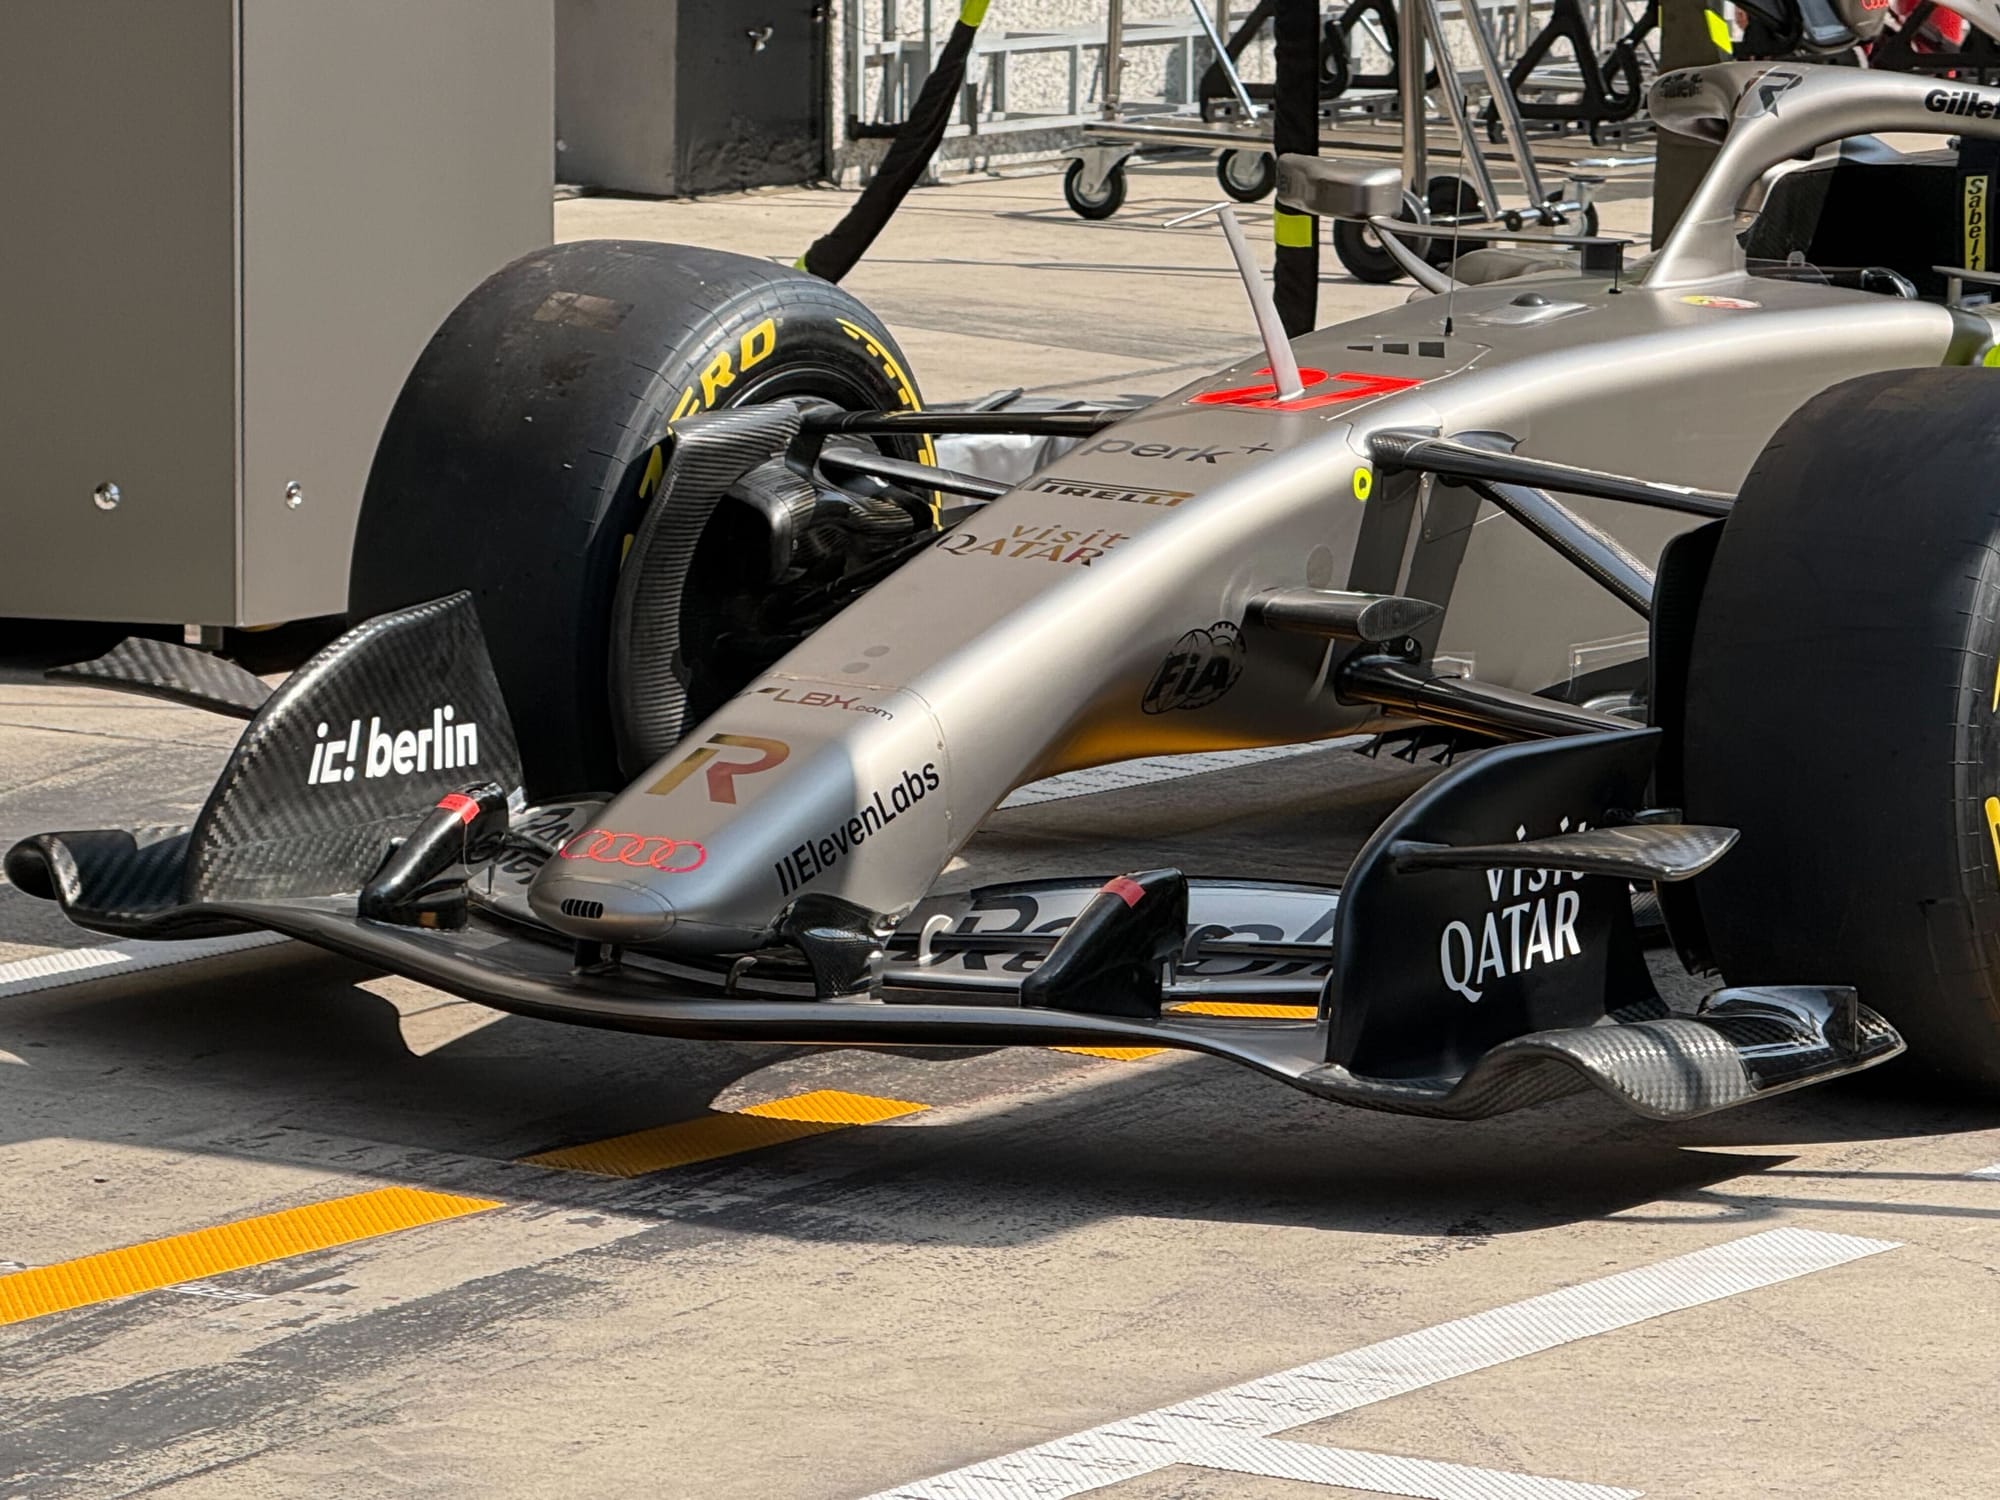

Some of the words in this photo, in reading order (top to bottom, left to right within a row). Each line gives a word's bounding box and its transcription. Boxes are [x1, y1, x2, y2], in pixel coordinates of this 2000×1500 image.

[1968, 178, 1985, 271] Sabelt
[1187, 367, 1425, 412] 27
[1018, 478, 1196, 507] PIRELLI
[936, 533, 1104, 567] QATAR
[1011, 524, 1131, 549] visit
[308, 722, 361, 785] ic!
[365, 705, 478, 778] berlin
[1440, 890, 1581, 1003] QATAR
